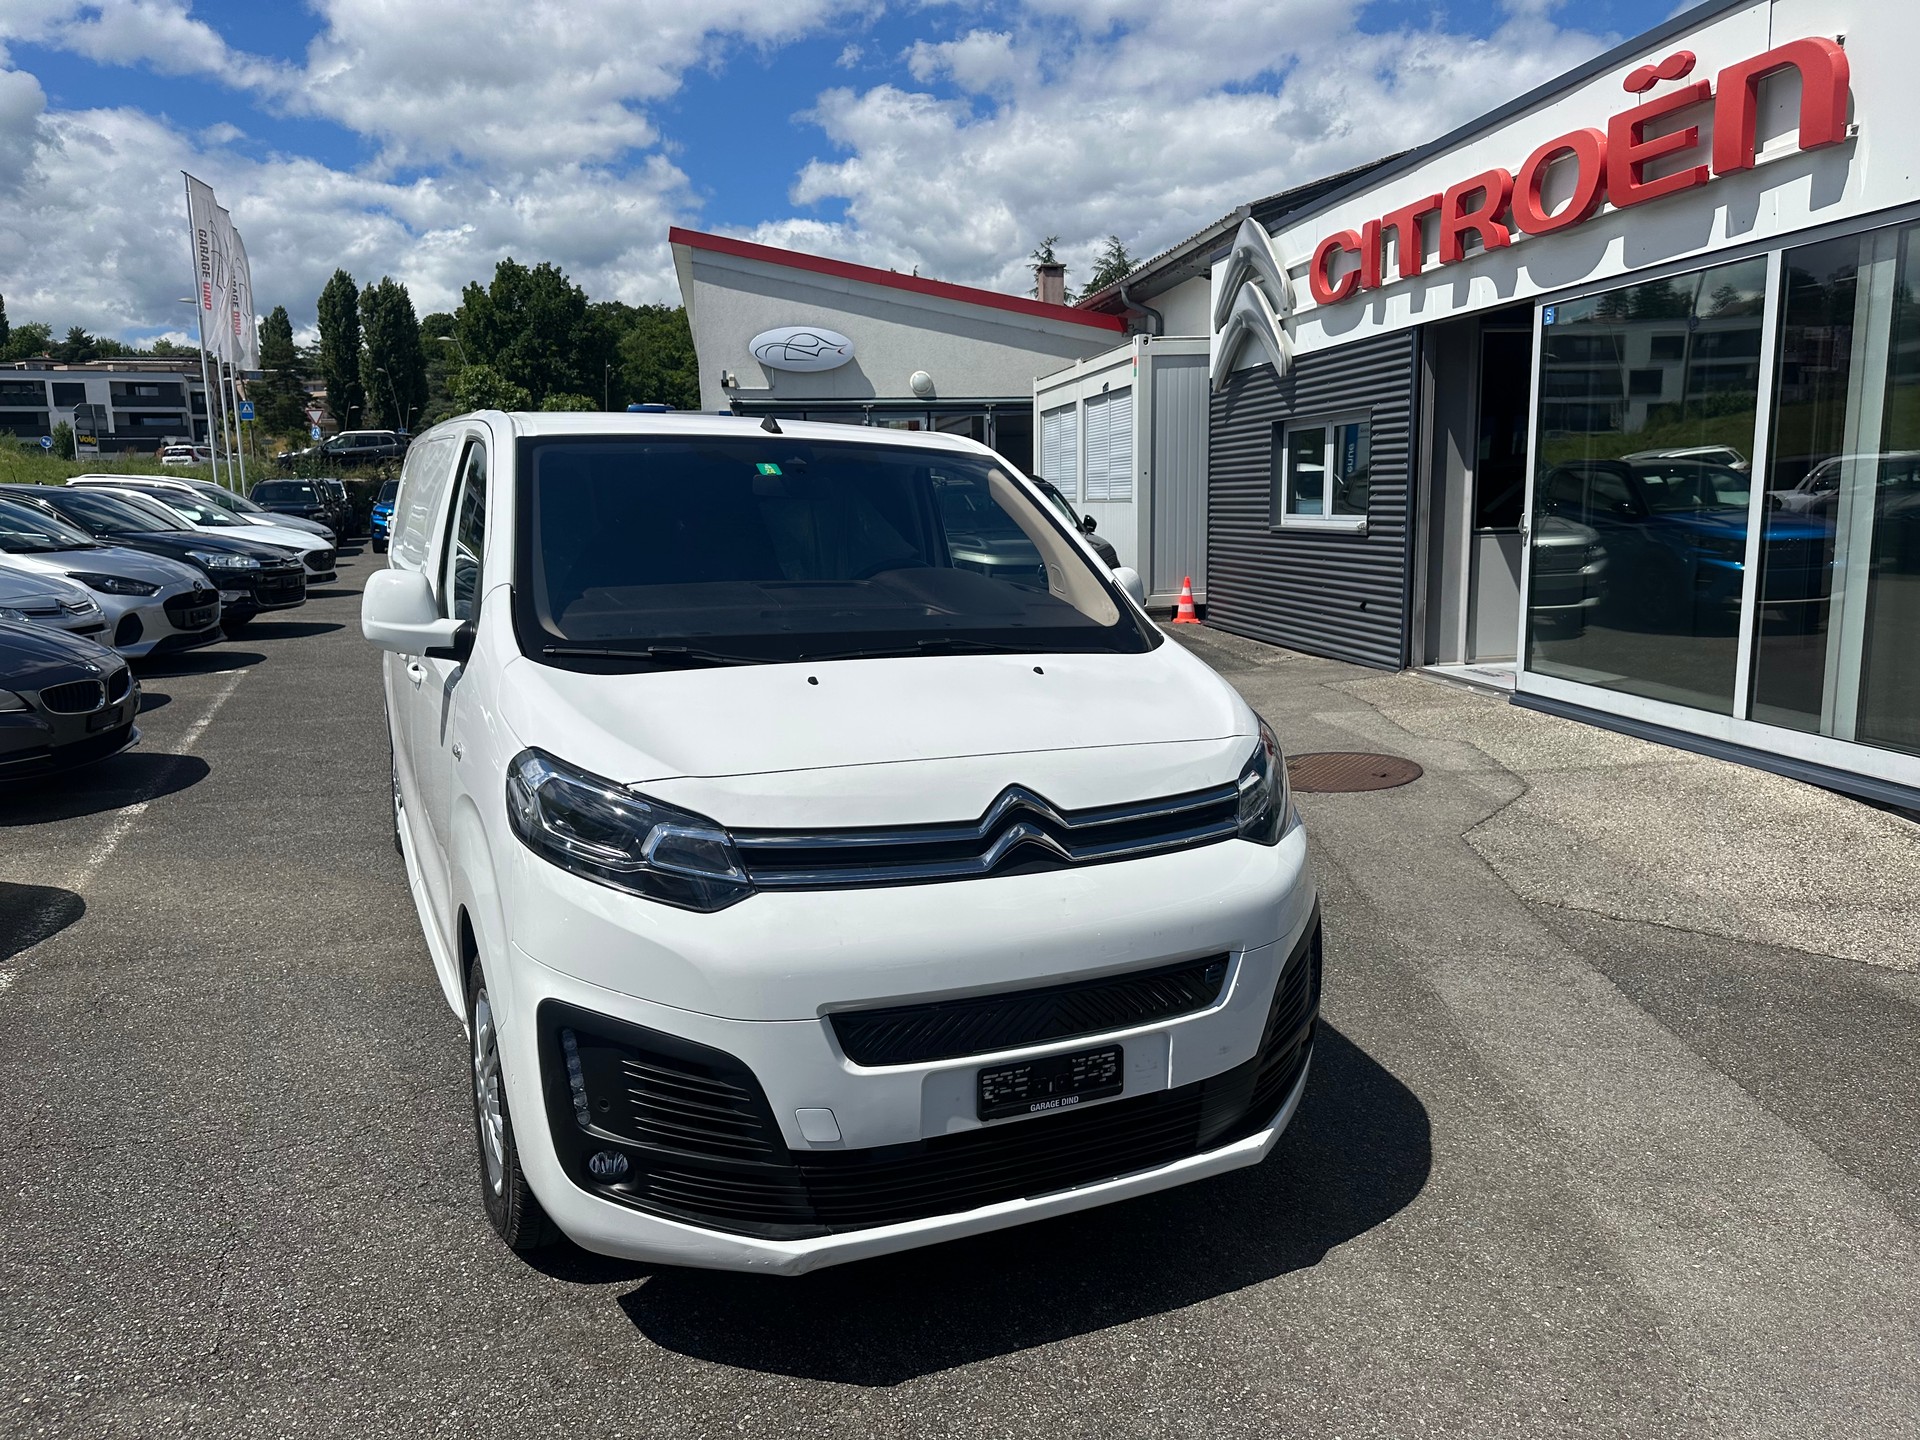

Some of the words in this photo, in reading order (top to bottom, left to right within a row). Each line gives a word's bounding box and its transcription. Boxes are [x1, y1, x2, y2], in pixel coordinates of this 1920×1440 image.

[198, 229, 211, 278] GARAGE
[79, 435, 97, 444] Volg
[1030, 1100, 1060, 1111] GARAGE
